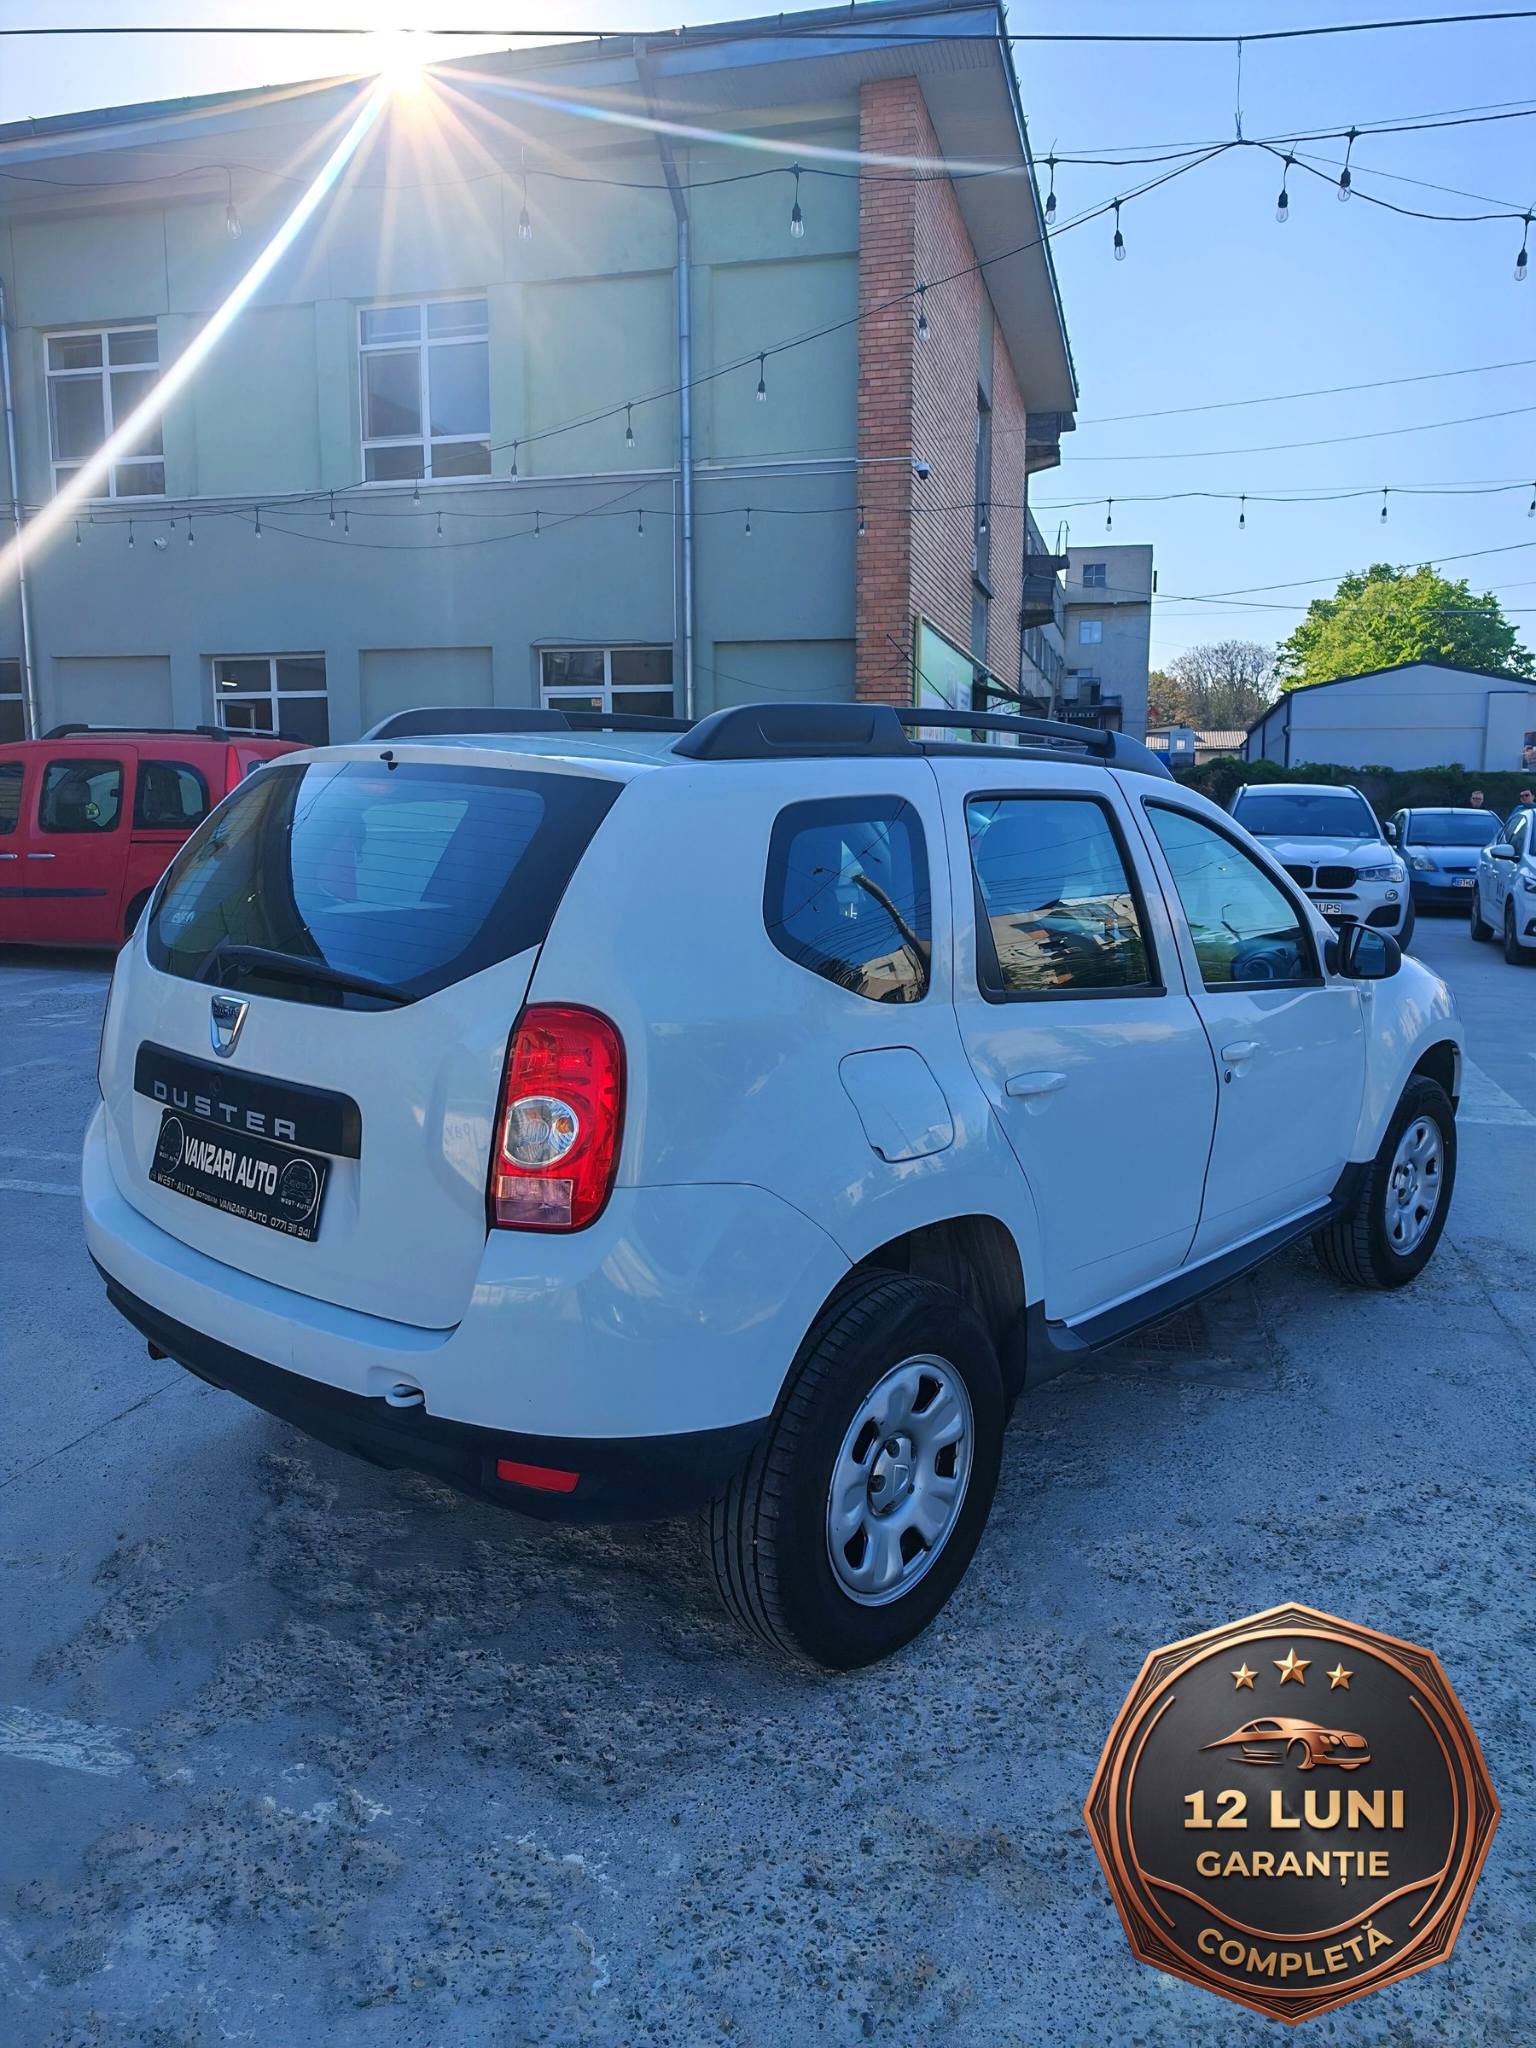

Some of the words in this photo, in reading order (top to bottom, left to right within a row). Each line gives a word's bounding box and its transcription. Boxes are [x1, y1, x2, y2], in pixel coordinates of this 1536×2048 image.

[153, 1080, 296, 1140] DUSTER
[184, 1135, 237, 1182] VANZARI
[235, 1155, 278, 1196] AUTO
[156, 1172, 195, 1197] WEST-AUTO
[219, 1198, 247, 1217] VANZARI
[247, 1209, 268, 1224] AUTO
